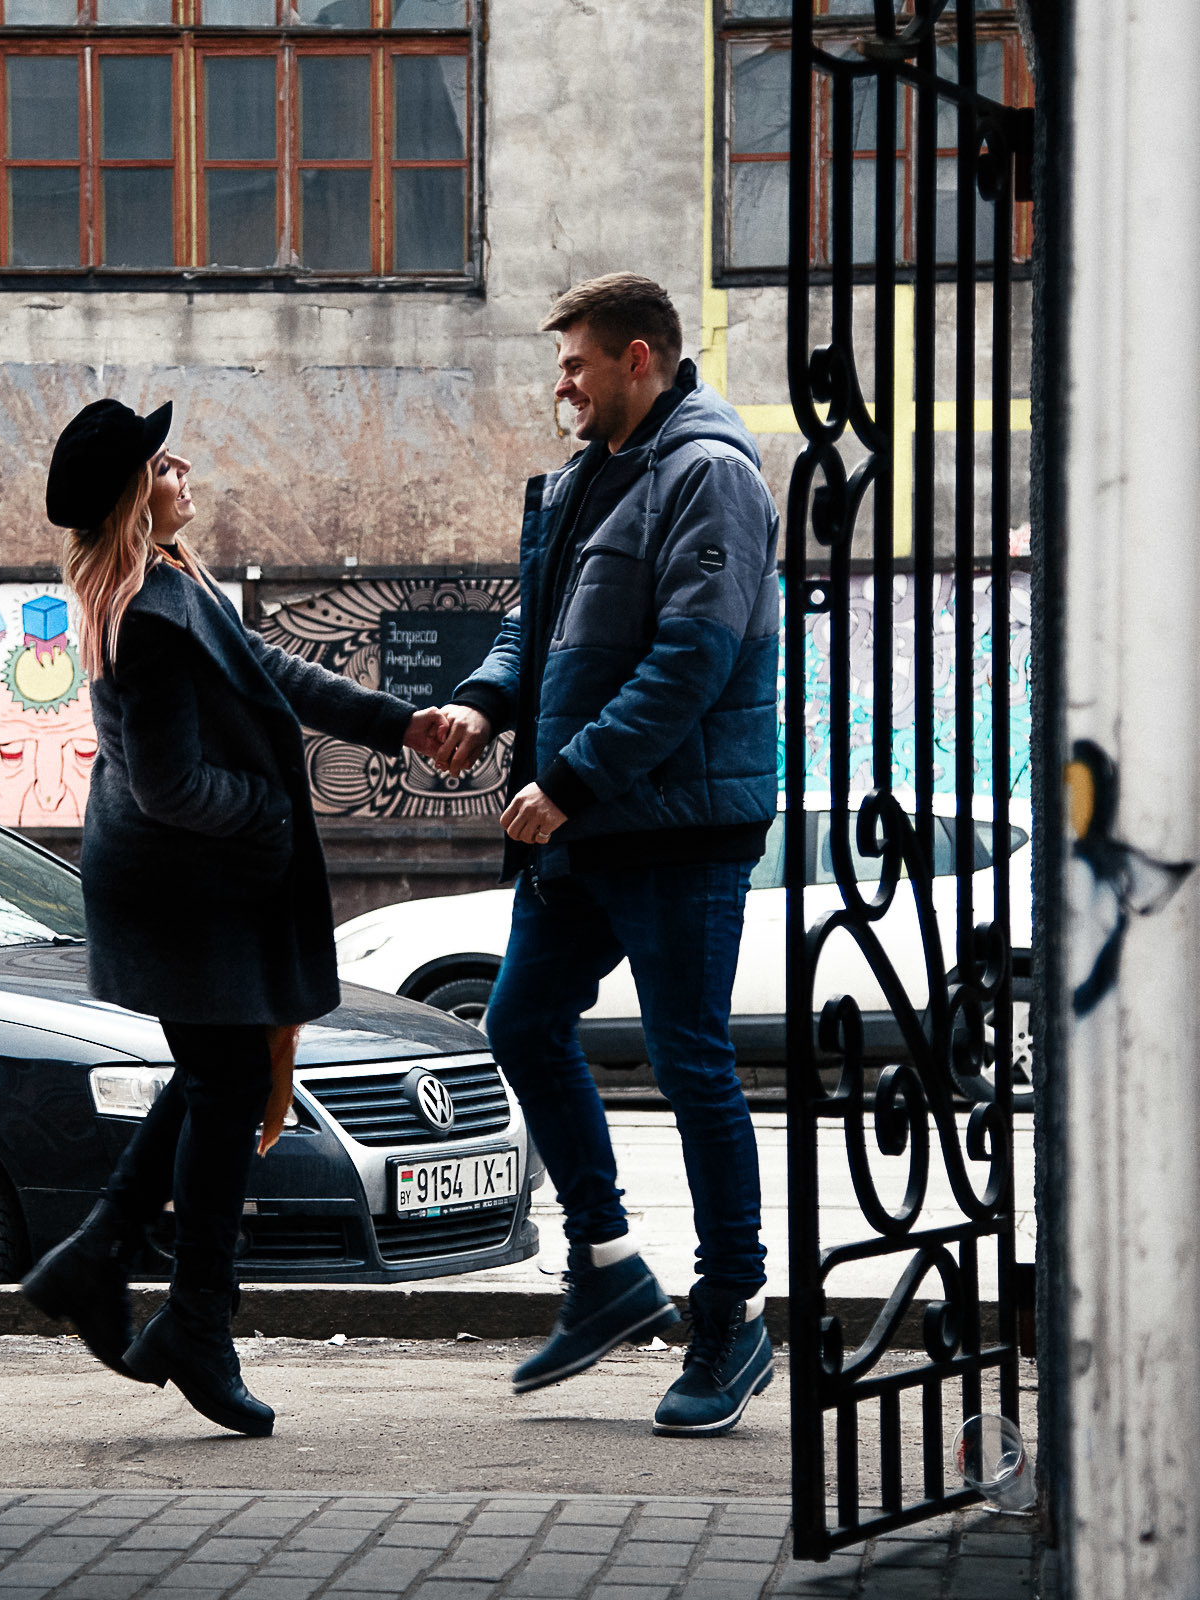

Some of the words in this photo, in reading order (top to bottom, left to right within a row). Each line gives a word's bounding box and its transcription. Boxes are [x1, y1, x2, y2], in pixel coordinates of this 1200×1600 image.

[386, 621, 438, 650] Эспрессо
[417, 1163, 463, 1203] 9154
[474, 1156, 512, 1196] IX-1
[400, 1190, 412, 1206] BY
